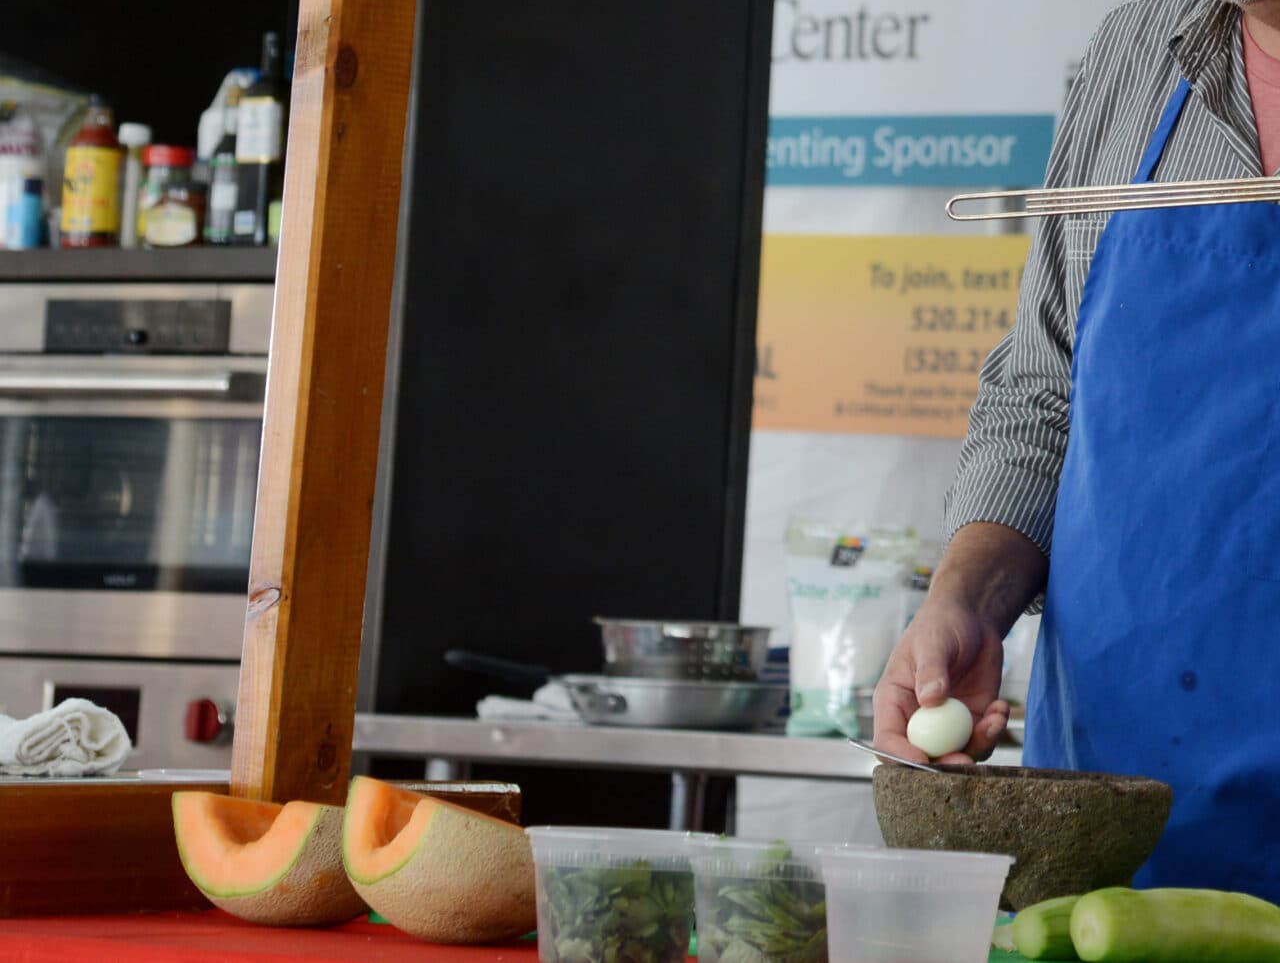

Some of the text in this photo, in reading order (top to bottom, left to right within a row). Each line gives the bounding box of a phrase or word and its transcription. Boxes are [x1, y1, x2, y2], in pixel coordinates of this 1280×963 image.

[872, 126, 1017, 176] Sponsor
[870, 262, 895, 289] To
[963, 265, 1011, 290] text
